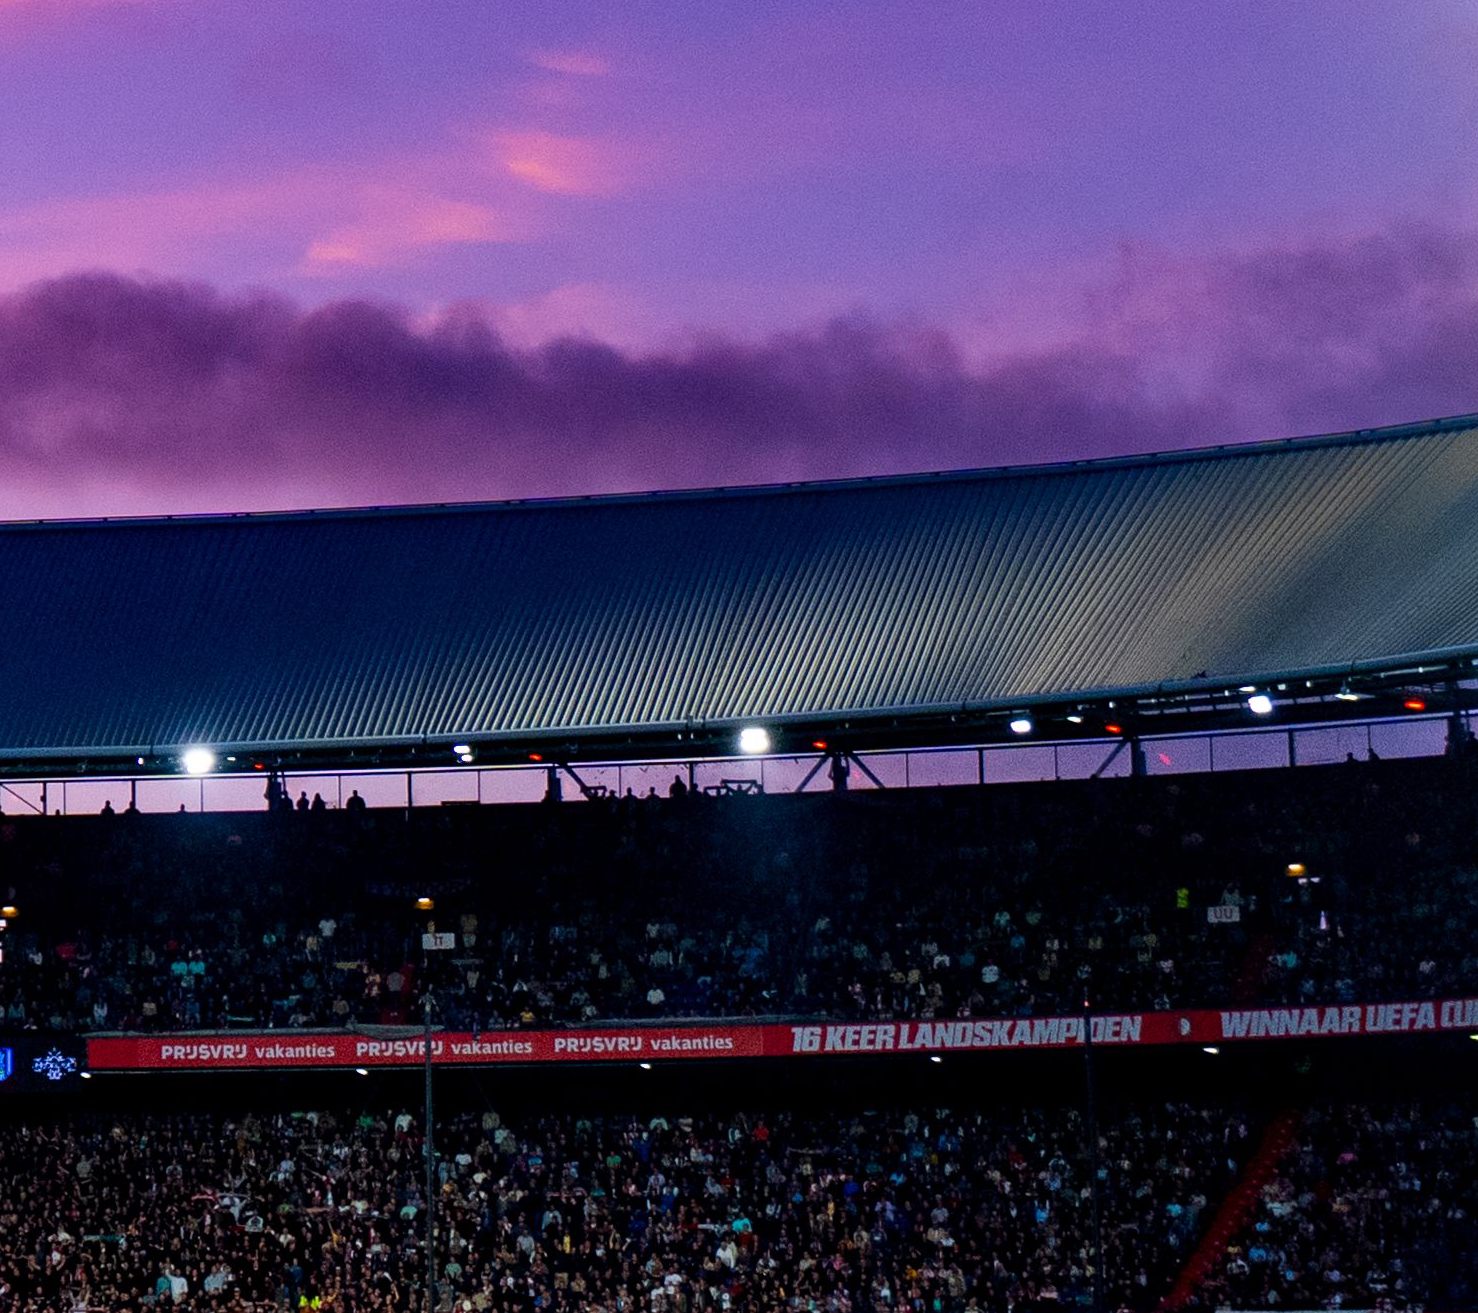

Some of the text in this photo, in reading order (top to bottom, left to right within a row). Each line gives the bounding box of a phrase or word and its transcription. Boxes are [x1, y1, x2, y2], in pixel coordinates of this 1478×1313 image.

[1220, 1004, 1362, 1037] WINNAAR
[1365, 1002, 1436, 1033] UEFA
[791, 1015, 1142, 1051] 16 KEER LANDSKAMPIOEN
[255, 1042, 335, 1059] vakanties
[451, 1039, 533, 1055] vakanties
[651, 1035, 733, 1051] vakanties
